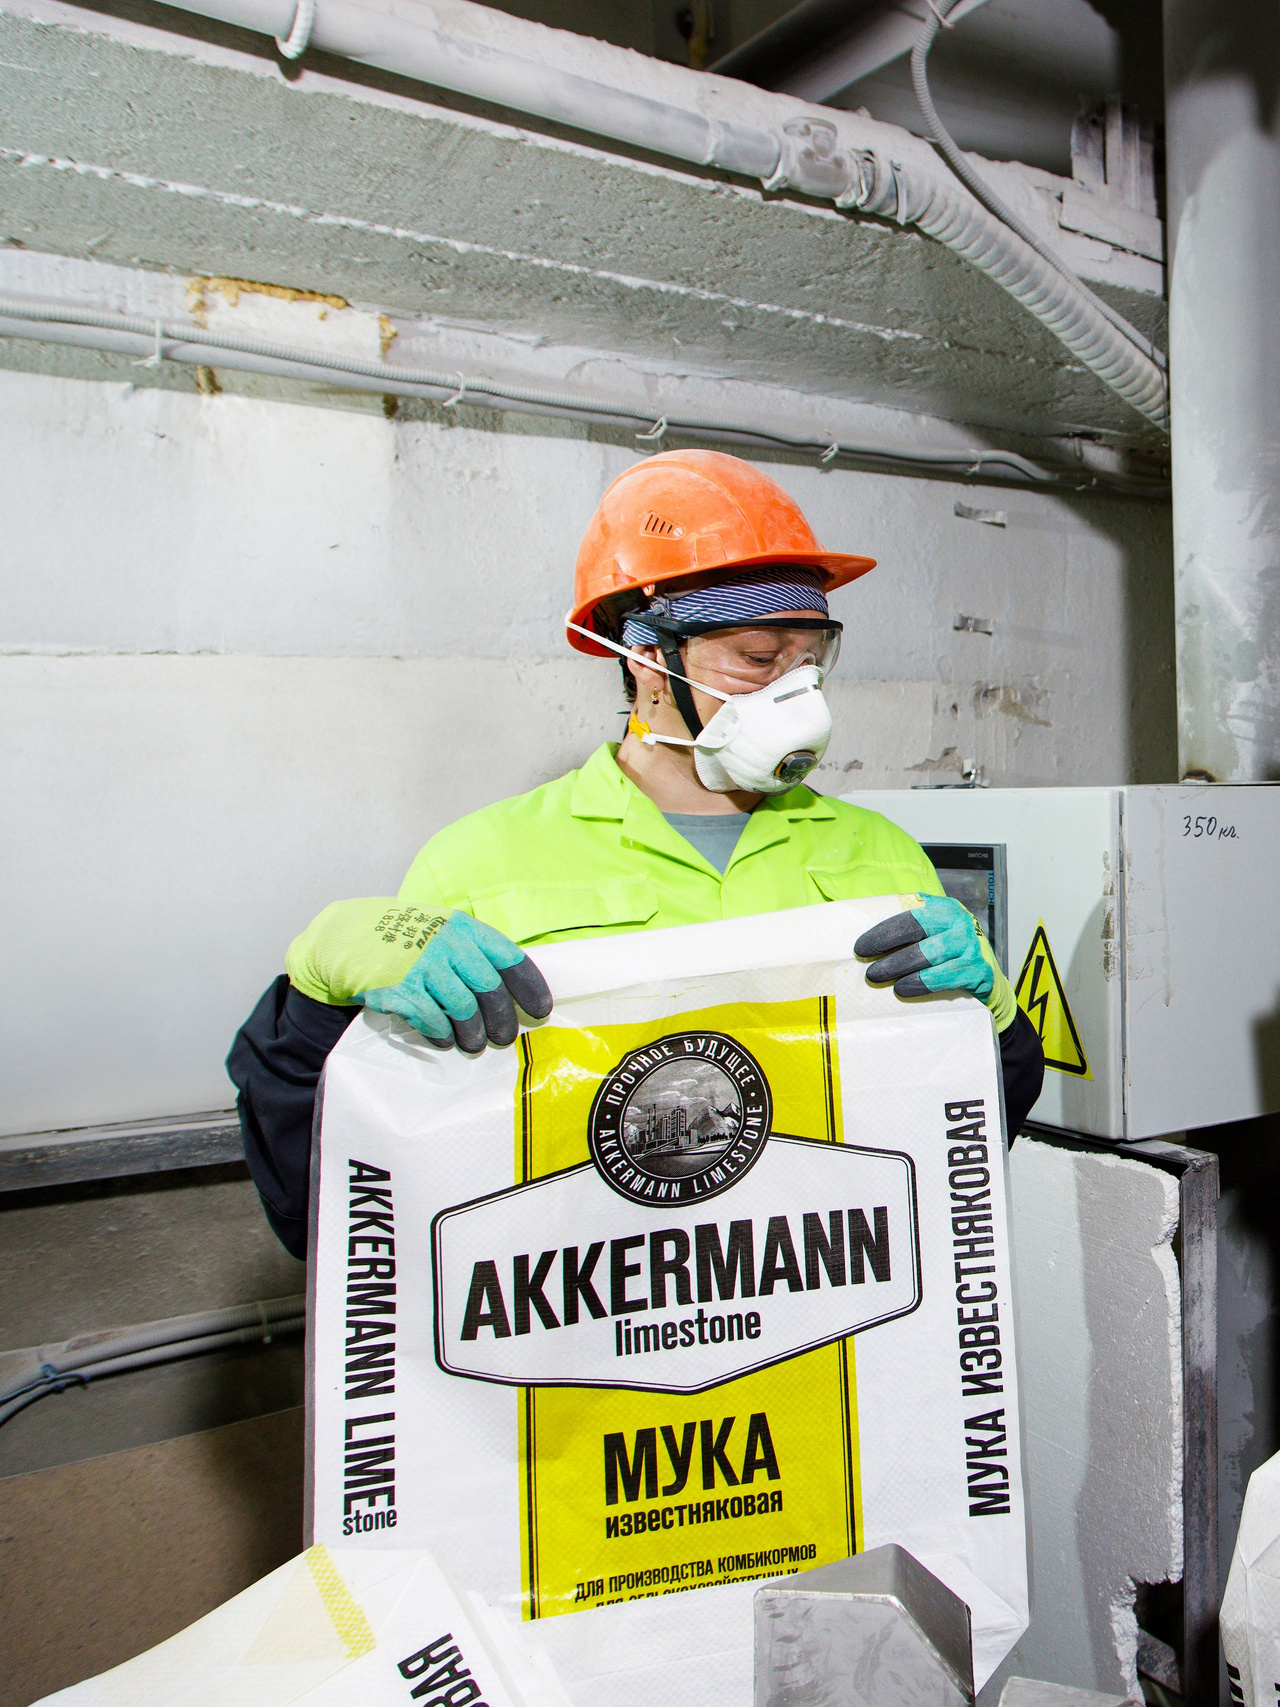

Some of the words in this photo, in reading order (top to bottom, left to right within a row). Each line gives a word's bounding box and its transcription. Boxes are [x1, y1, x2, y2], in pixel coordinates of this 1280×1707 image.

[605, 1044, 674, 1106] ПРОЧНОЕ
[683, 1038, 756, 1087] БУДУЩЕЕ
[599, 1129, 681, 1198] AKKERMANN
[692, 1104, 763, 1194] LIMESTONE
[344, 1158, 397, 1401] AKKERMANN
[460, 1206, 892, 1341] AKKERMANN
[944, 1098, 1004, 1397] ИЗВЕСТНЯКОВАЯ
[615, 1309, 762, 1356] limestone
[343, 1411, 396, 1516] LIME
[603, 1411, 781, 1506] МУКА
[963, 1407, 1011, 1518] МУКА
[342, 1509, 398, 1537] stone
[605, 1490, 783, 1539] известняковая
[575, 1579, 604, 1603] ДЛЯ
[609, 1559, 714, 1594] ПРОИЗВОДСТВА
[718, 1543, 817, 1573] КОМБИКОРМОВ
